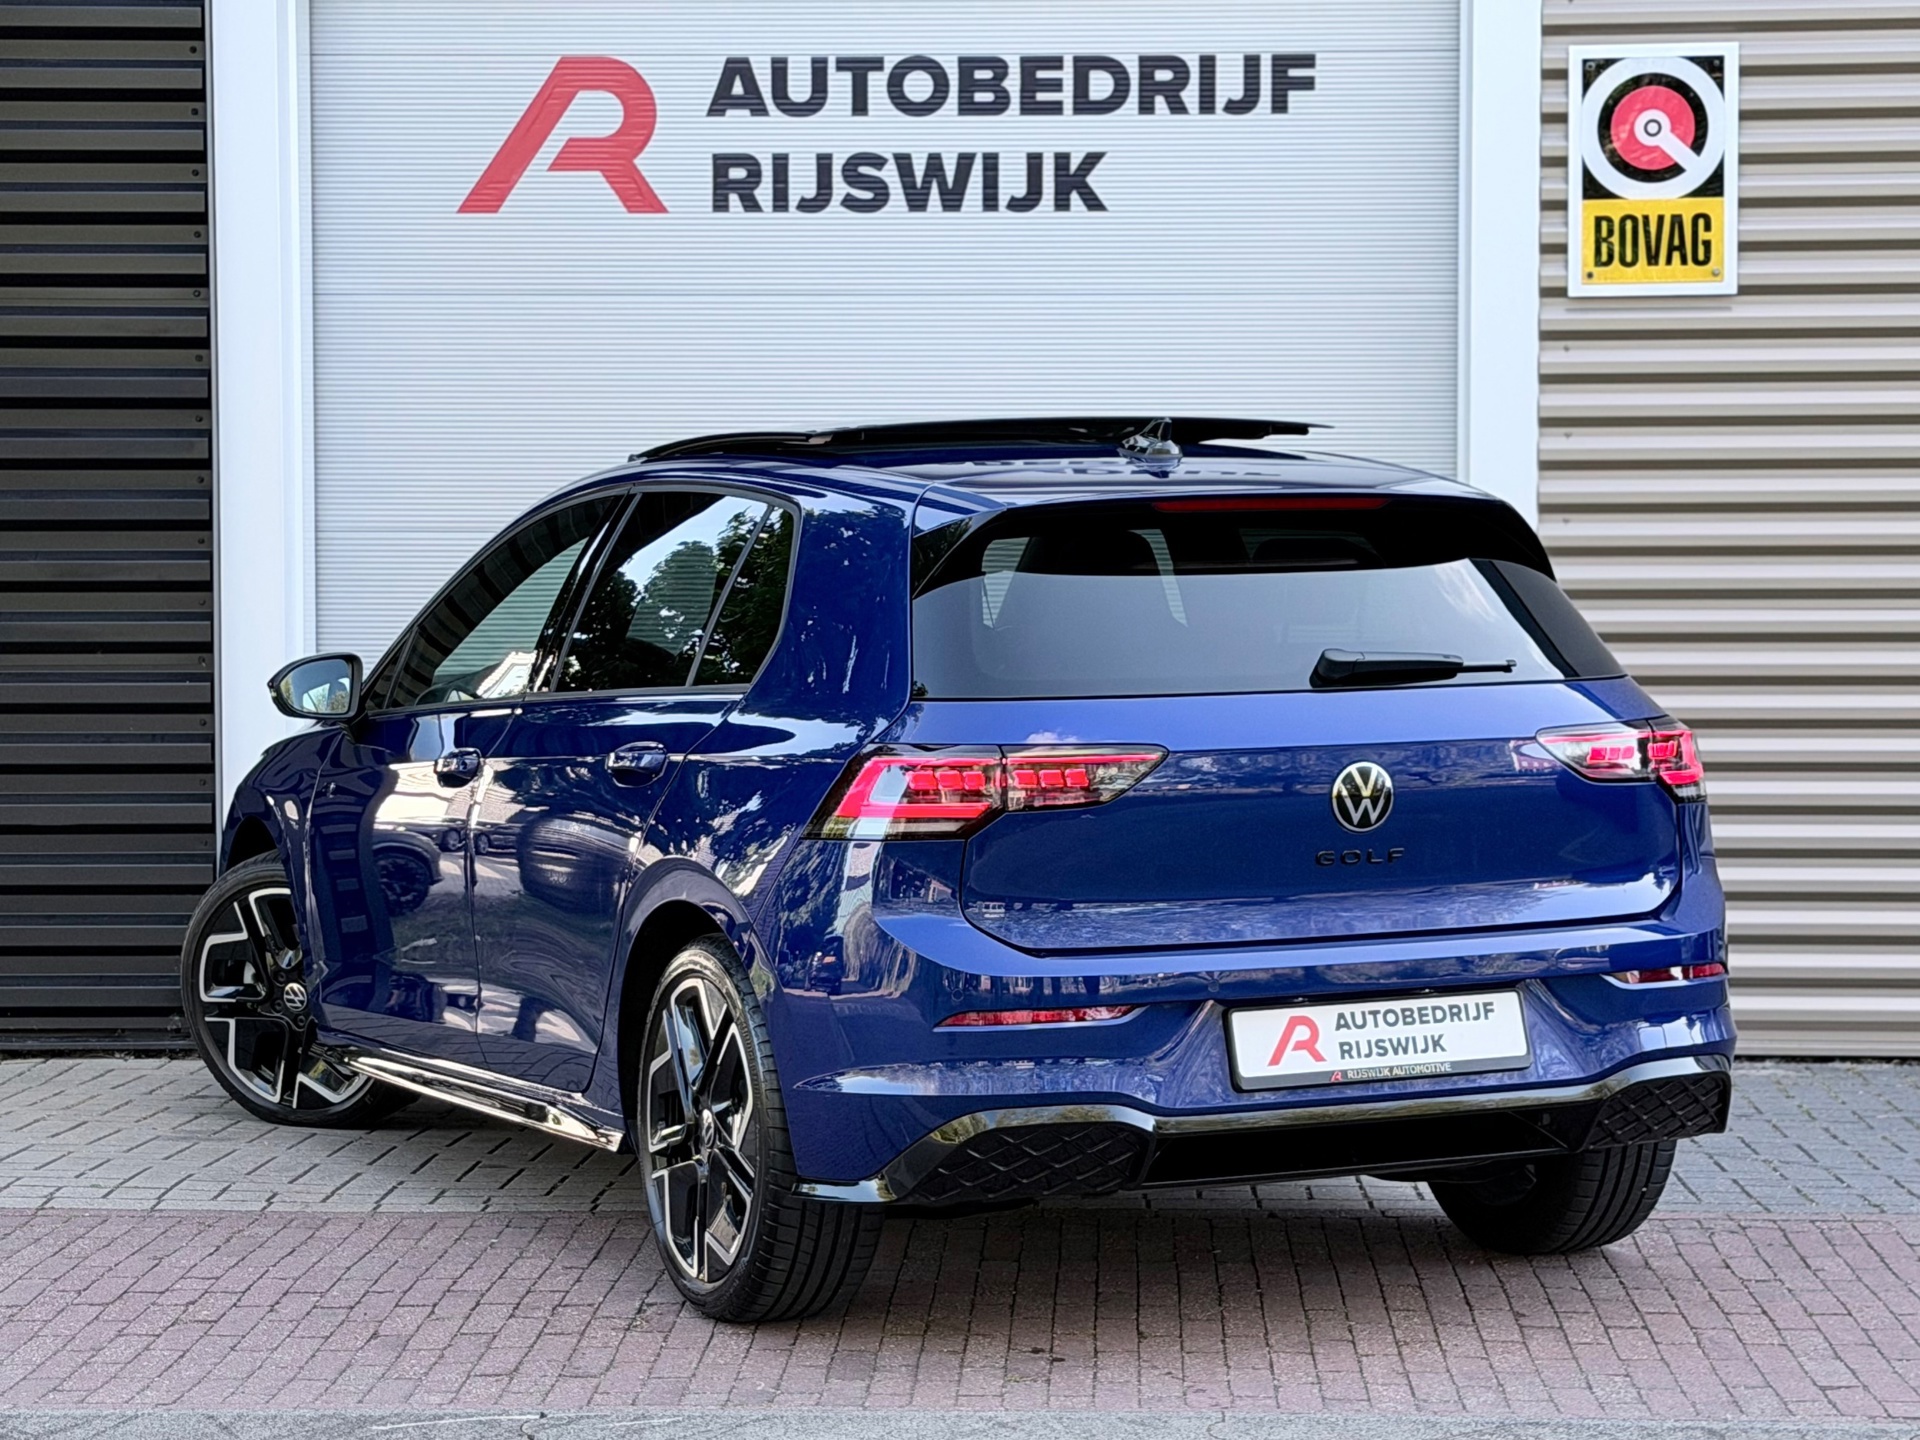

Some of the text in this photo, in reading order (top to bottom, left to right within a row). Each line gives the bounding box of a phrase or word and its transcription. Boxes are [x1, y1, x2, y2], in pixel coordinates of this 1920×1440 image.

[707, 53, 1316, 118] AUTOBEDRIJF
[711, 151, 1108, 213] RIJSWIJK
[1594, 212, 1713, 268] BOVAG
[1315, 847, 1405, 866] GOLF
[1334, 1001, 1496, 1032] AUTOBEDRIJF
[1338, 1033, 1447, 1061] RIJSWIJK
[1346, 1068, 1391, 1080] RIJSWIJK
[1392, 1062, 1452, 1076] AUTOMOTIVE
